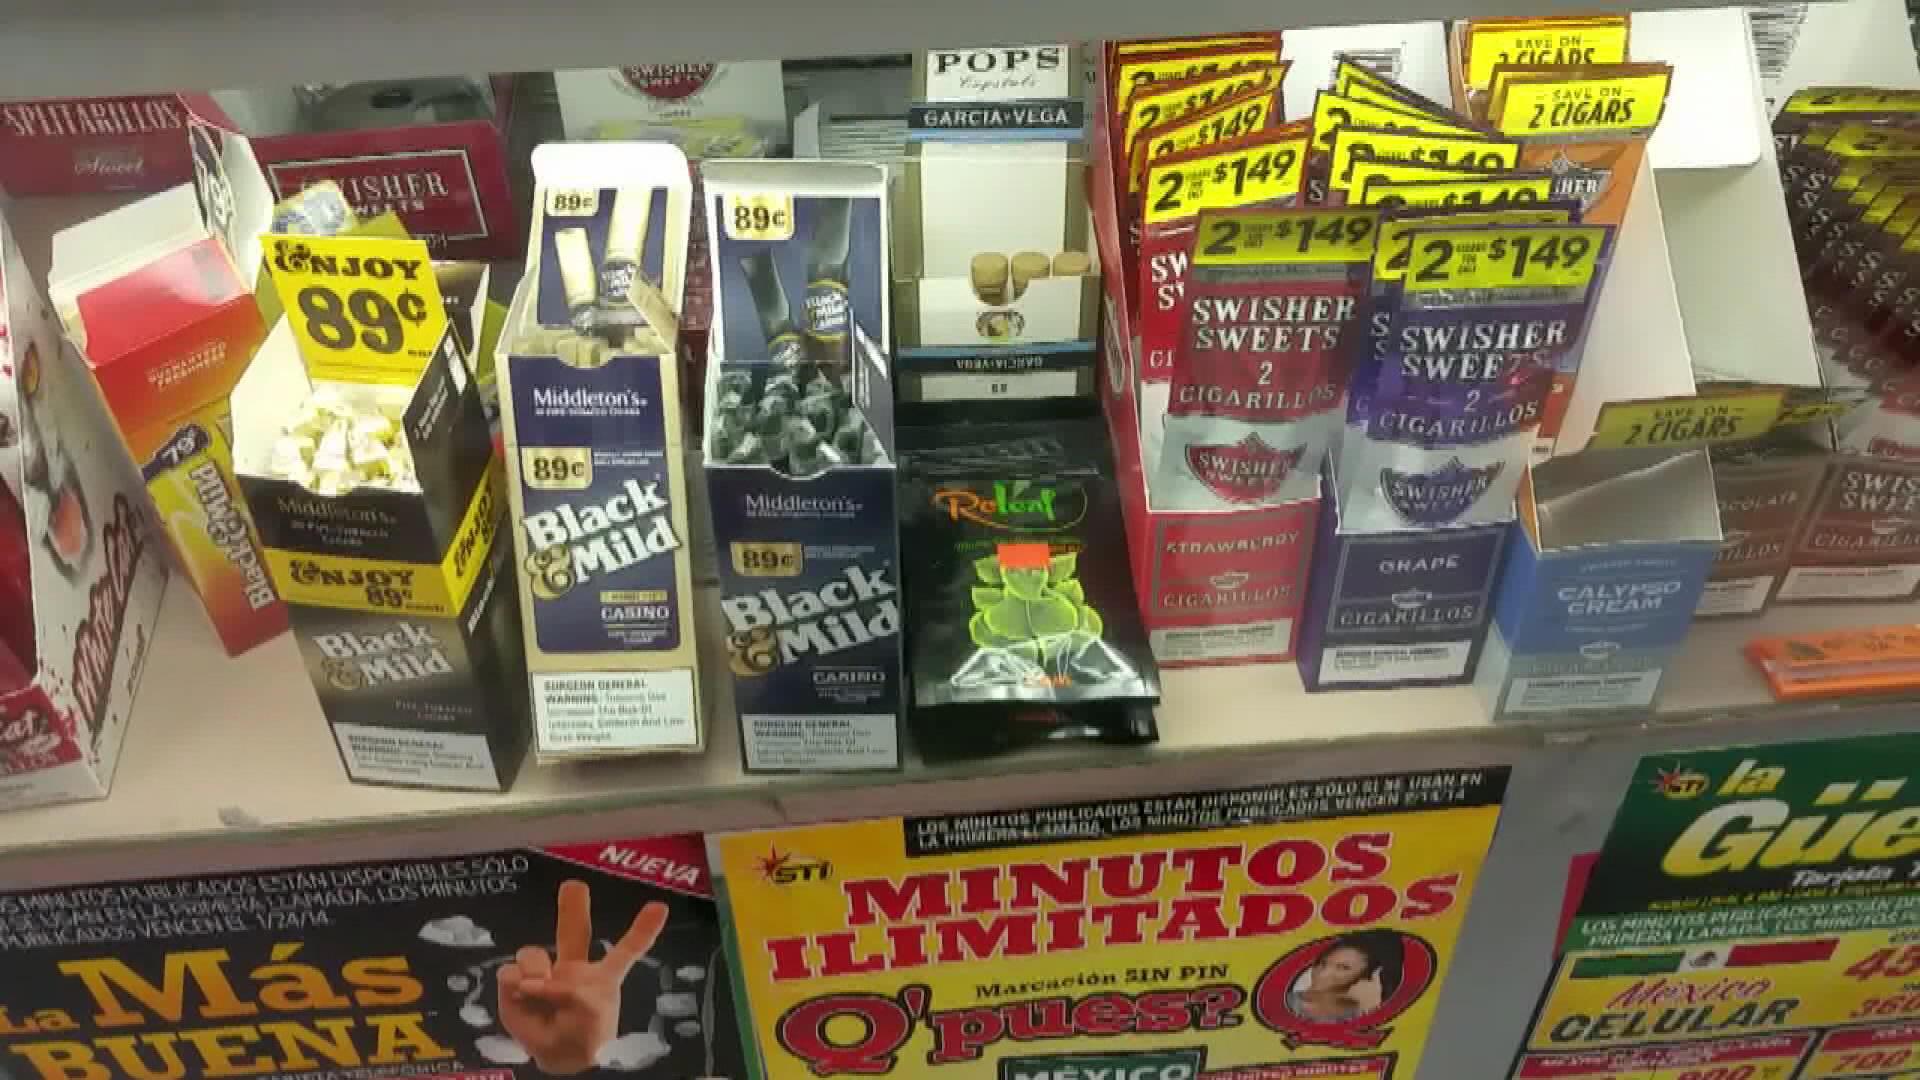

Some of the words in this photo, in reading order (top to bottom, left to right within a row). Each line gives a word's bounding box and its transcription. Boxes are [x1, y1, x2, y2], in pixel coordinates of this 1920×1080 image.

[934, 48, 1060, 74] POPS
[1599, 86, 1623, 97] ON
[1527, 103, 1545, 129] 2
[1550, 97, 1635, 128] CIGARS
[1153, 171, 1184, 212] 2
[1203, 221, 1241, 256] 2
[1415, 239, 1453, 283] 2
[297, 286, 429, 354] 89¢
[1191, 296, 1356, 325] SWISHER
[1195, 325, 1341, 353] SWEETS
[1401, 319, 1568, 353] SWISHER
[1257, 360, 1273, 386] 2
[533, 386, 641, 407] Middleton's
[1179, 383, 1336, 410] CIGARILLOS
[1379, 400, 1538, 437] CIGARILLOS
[1625, 425, 1642, 446] 2
[1648, 416, 1741, 445] CIGARS
[521, 478, 669, 550] Black
[571, 514, 682, 584] Mild
[1165, 530, 1300, 555] STRAWBERRY
[1378, 555, 1462, 576] GRAPE
[721, 565, 898, 632] Black
[1556, 580, 1683, 601] CALYPSO
[1566, 596, 1663, 616] CREAM
[600, 605, 671, 622] CASINO
[312, 621, 443, 659] Black
[776, 599, 900, 665] Mild
[359, 647, 454, 686] Mild
[1716, 758, 1786, 797] la
[598, 843, 701, 888] NUEVA
[842, 830, 1392, 928] MINUTOS
[764, 872, 1463, 984] ILIMITADOS
[56, 941, 425, 1028] Más
[1125, 966, 1171, 984] SIN
[1179, 963, 1228, 981] PIN
[1548, 997, 1802, 1043] CELULAR
[8, 1011, 457, 1080] BUENA
